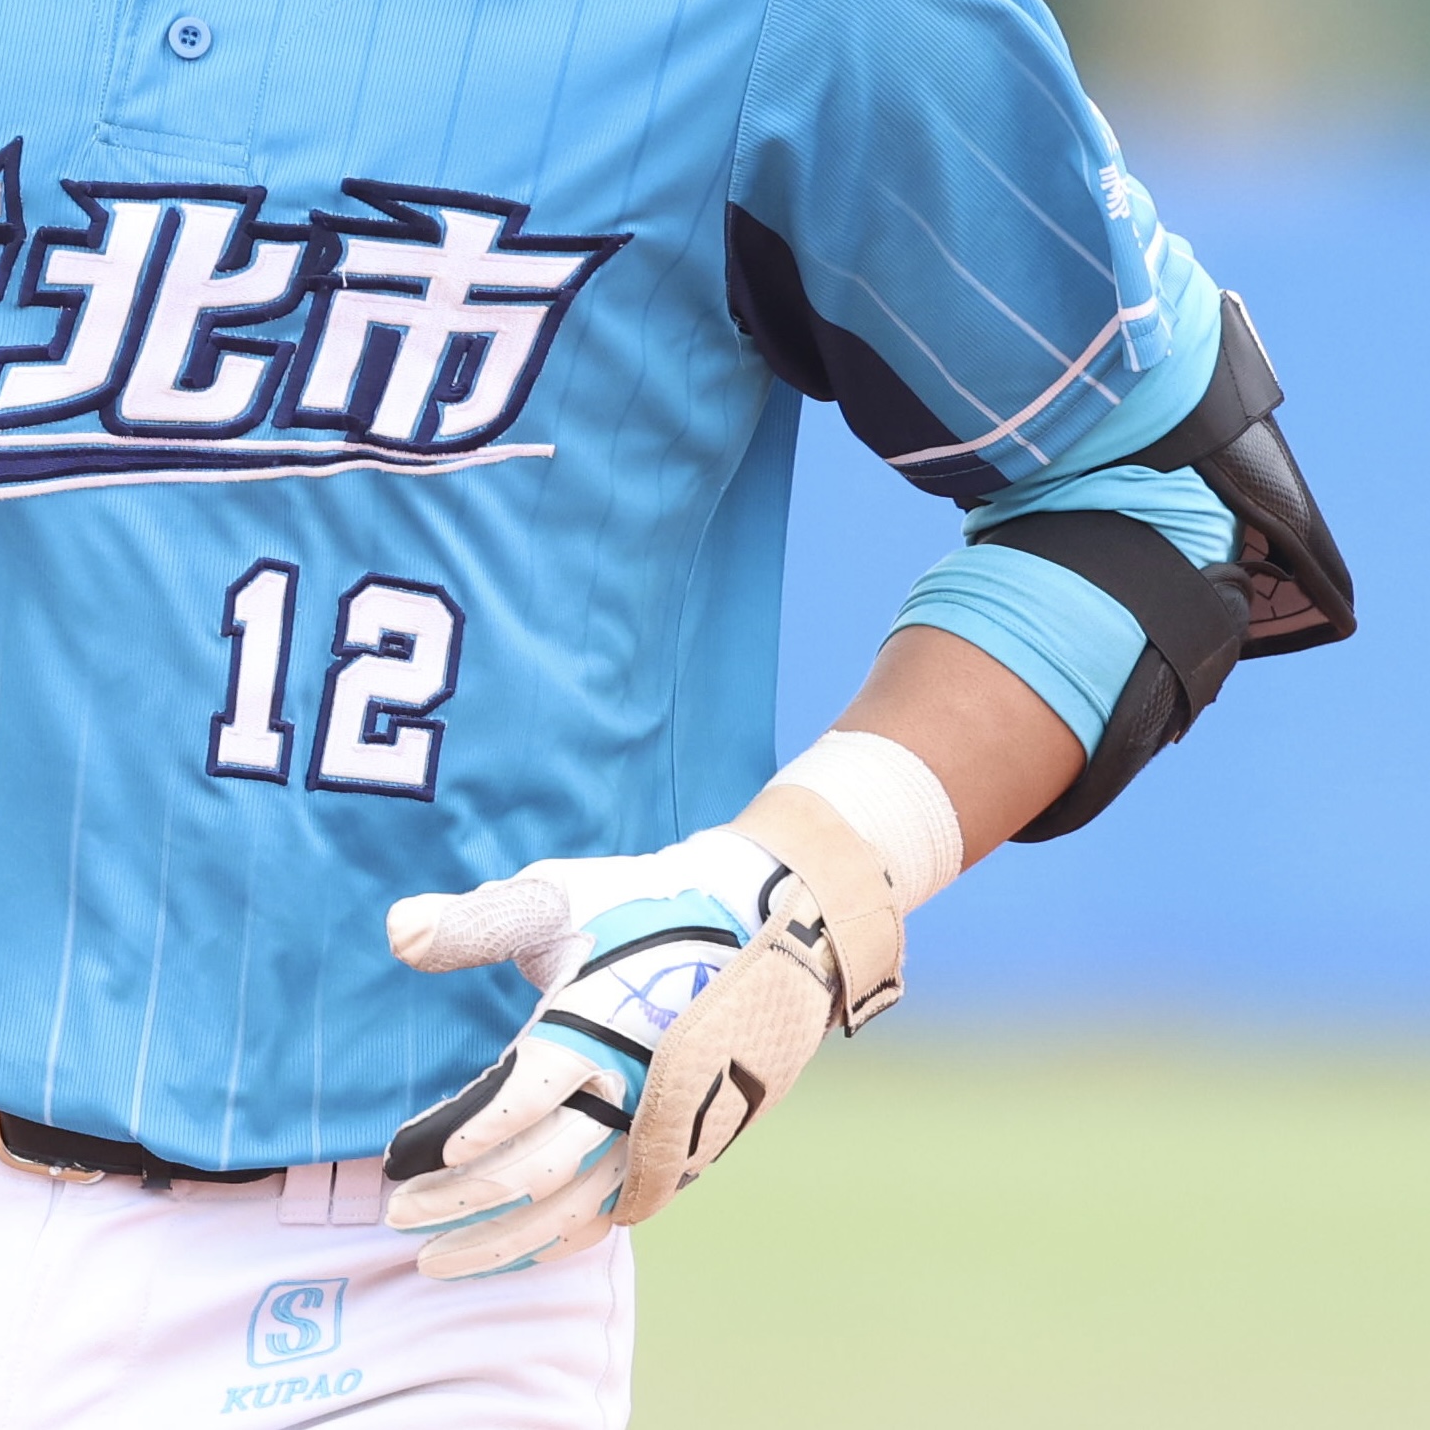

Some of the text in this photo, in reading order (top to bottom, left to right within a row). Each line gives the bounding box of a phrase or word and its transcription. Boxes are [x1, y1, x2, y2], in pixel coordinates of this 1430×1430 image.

[207, 558, 465, 801] 12
[265, 1287, 324, 1355] S
[220, 1368, 363, 1414] KUPAO
